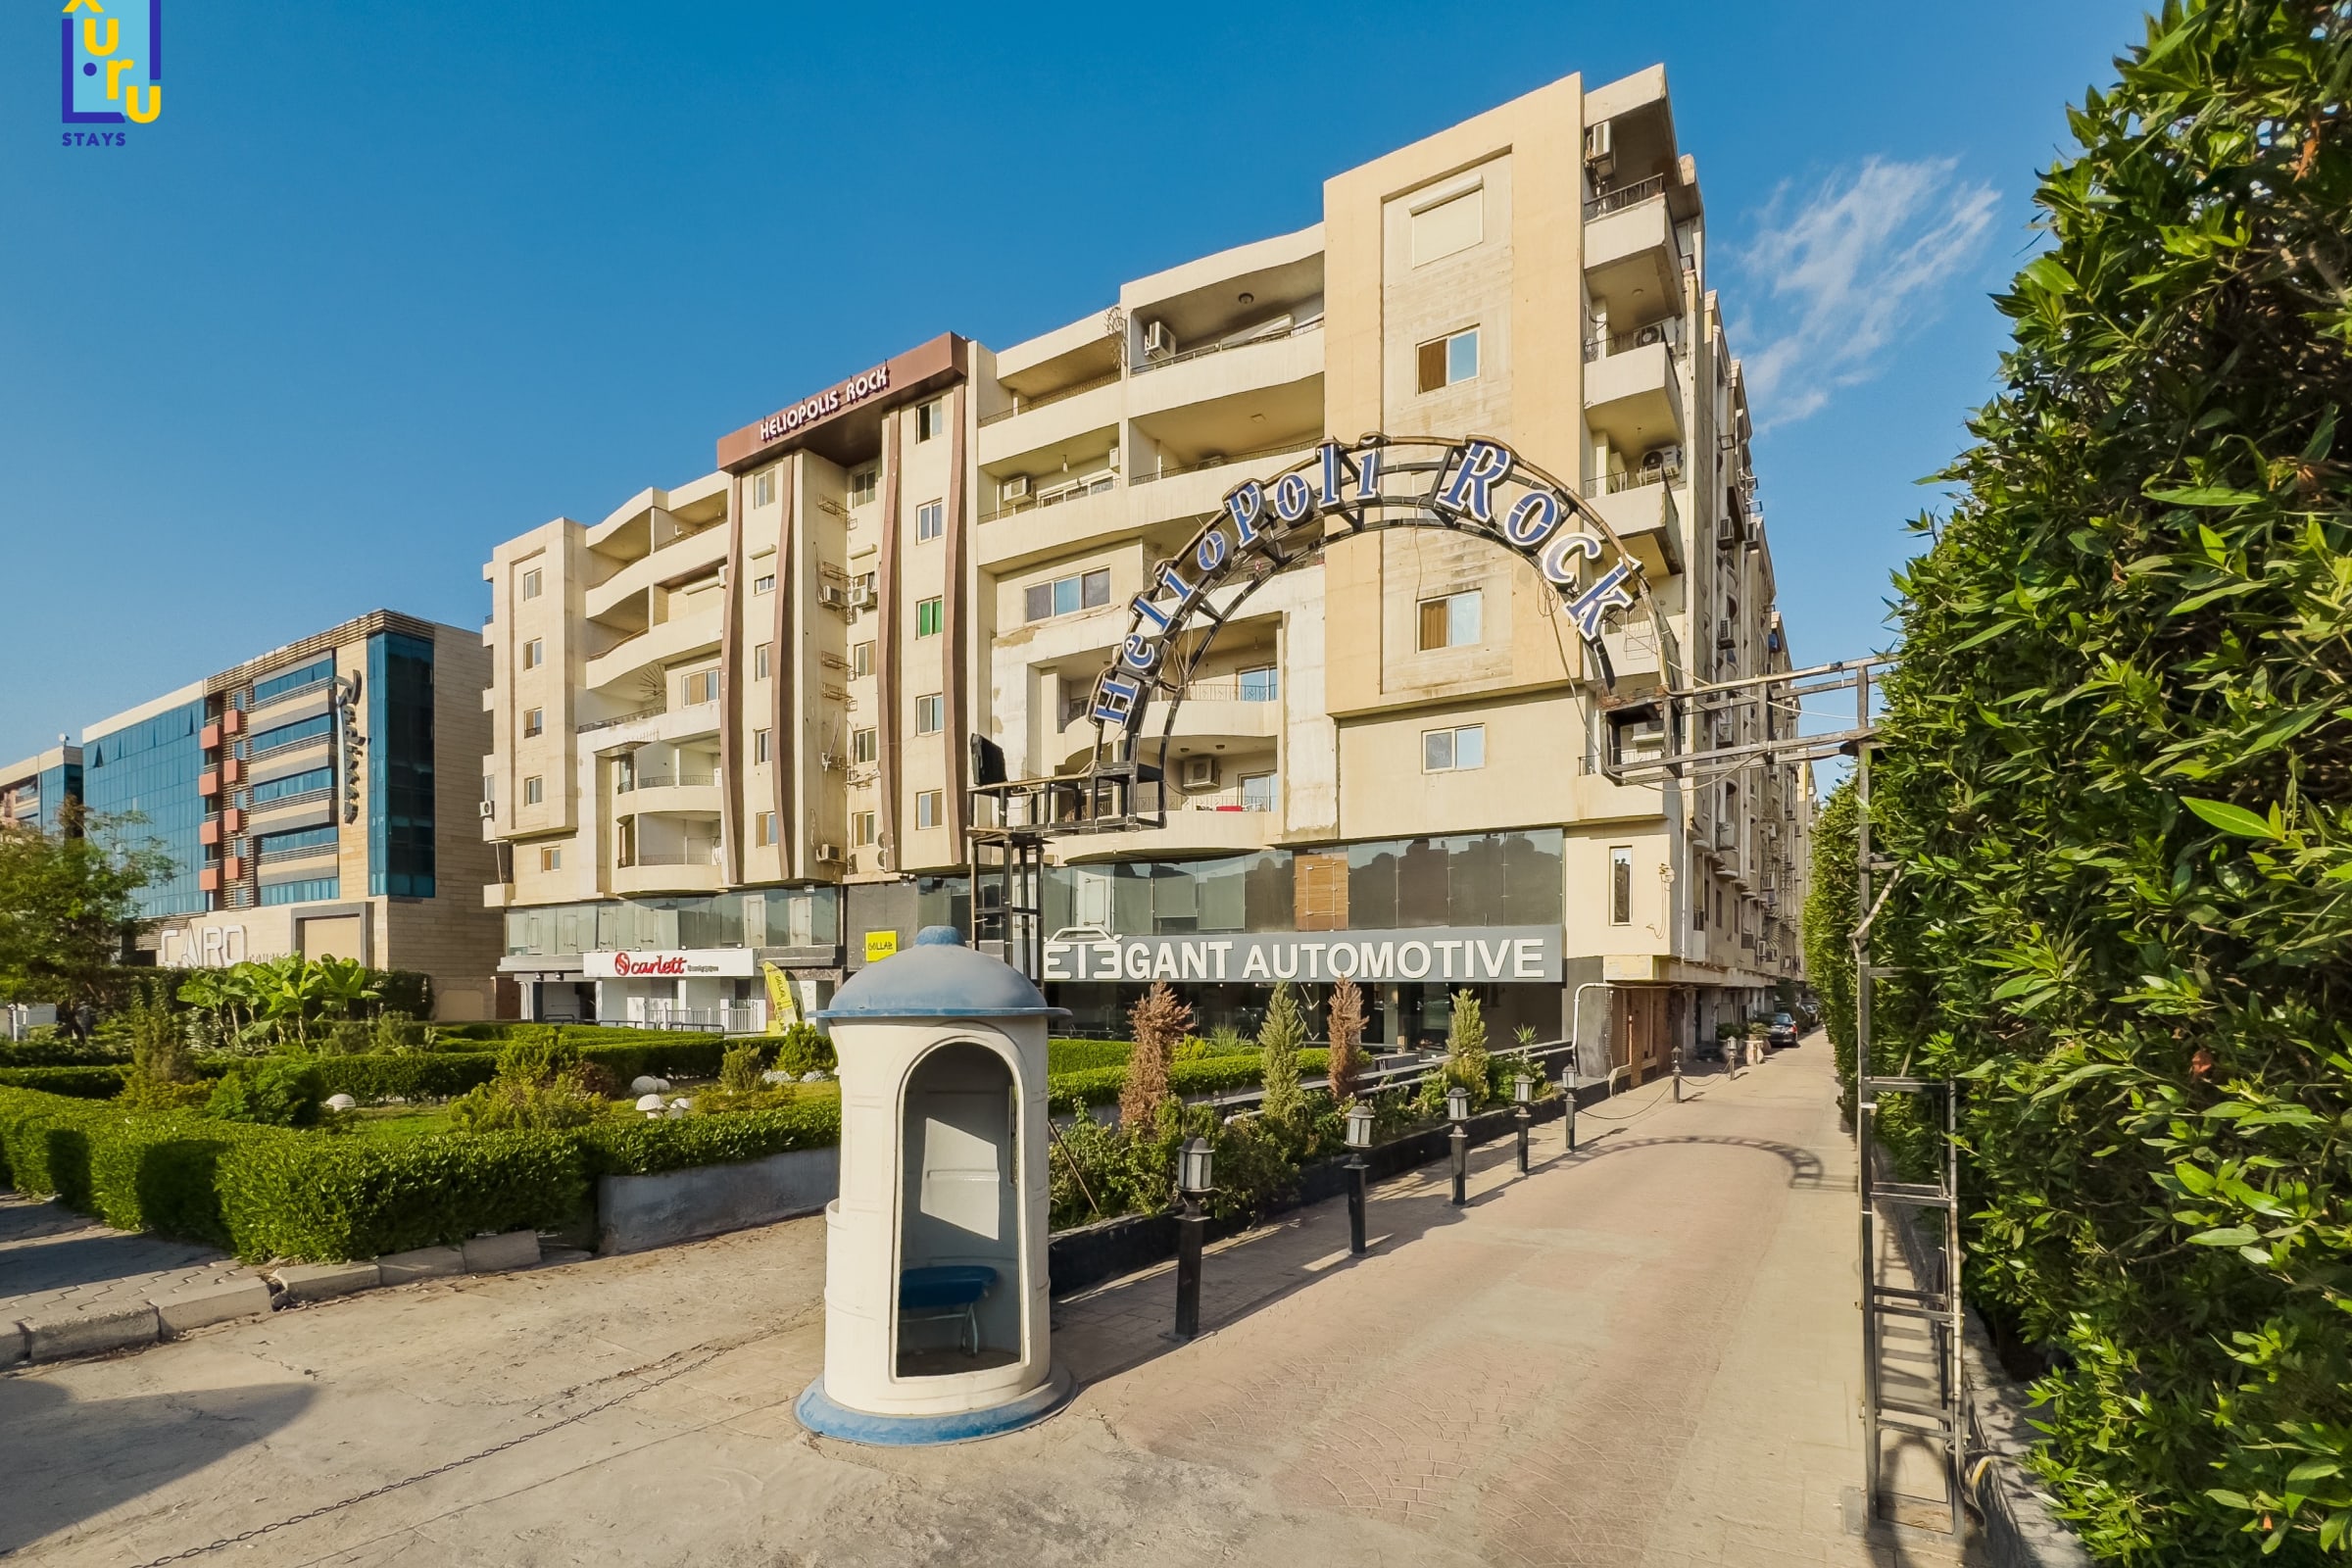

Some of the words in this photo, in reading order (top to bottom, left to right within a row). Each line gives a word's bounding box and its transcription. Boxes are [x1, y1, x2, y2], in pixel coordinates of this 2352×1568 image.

[760, 390, 840, 442] HELIOPOLIS
[846, 366, 890, 404] ROCK
[614, 952, 688, 976] Scarlett
[1241, 937, 1545, 980] AUTOMOTIVE
